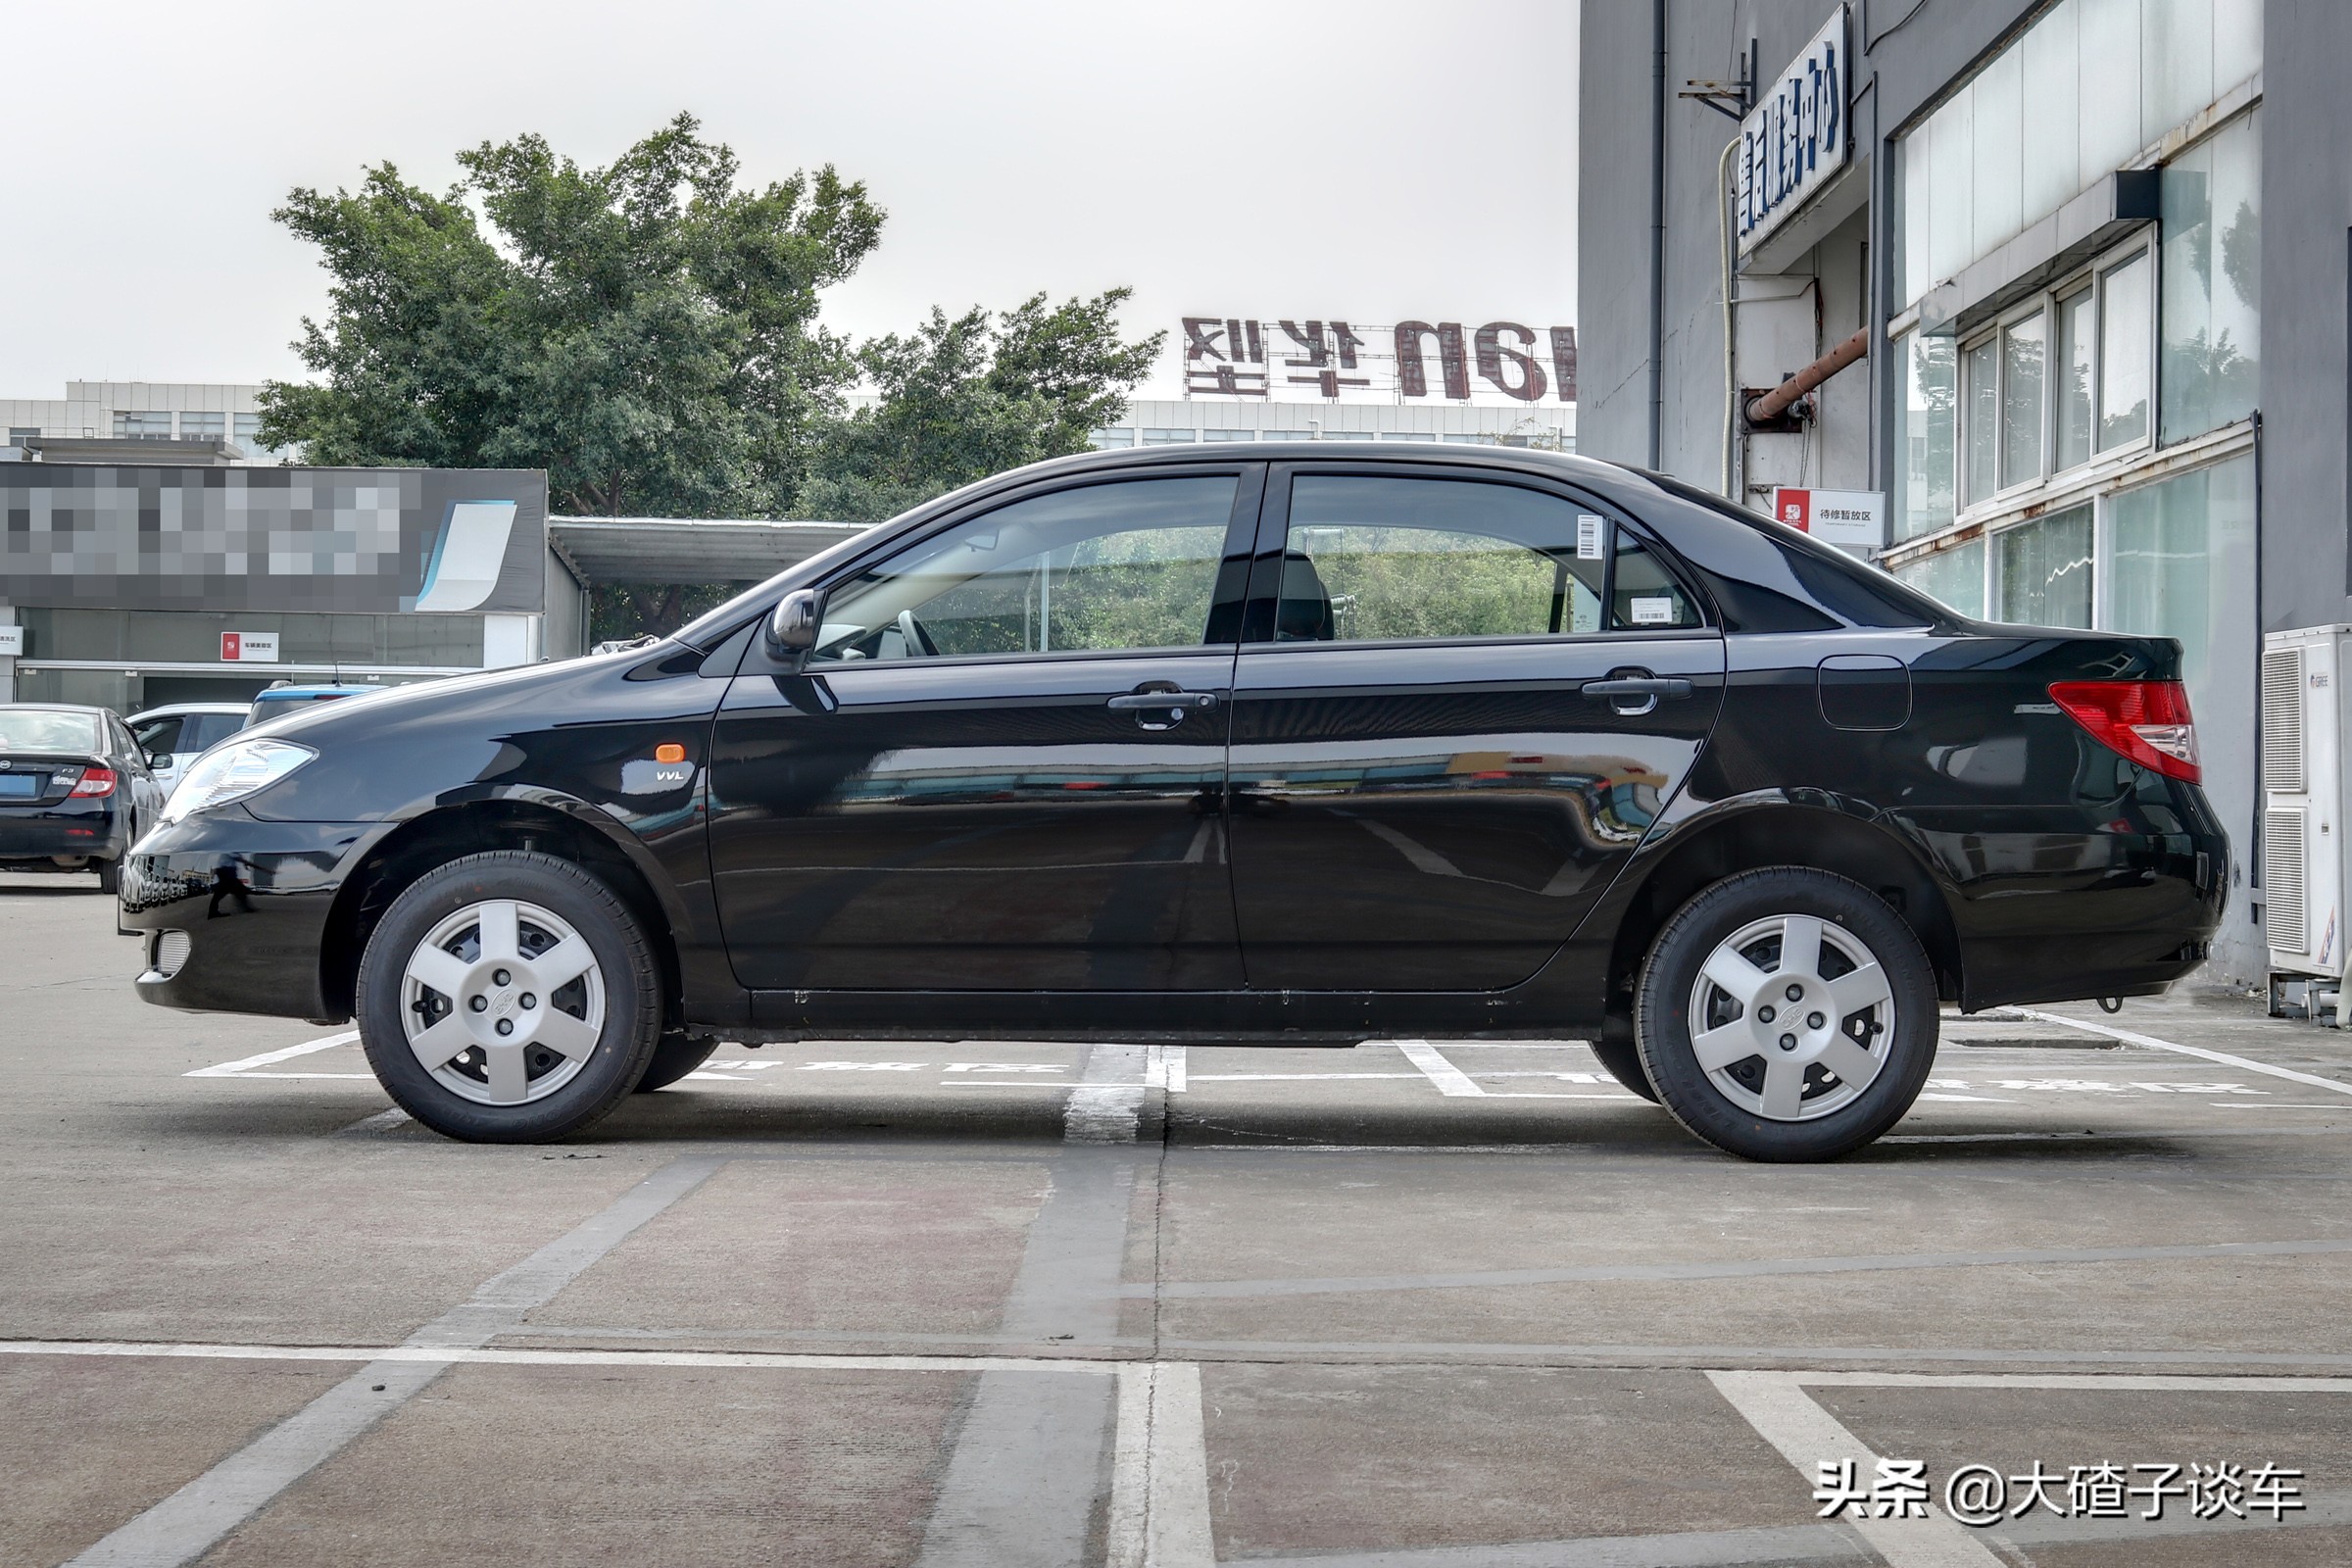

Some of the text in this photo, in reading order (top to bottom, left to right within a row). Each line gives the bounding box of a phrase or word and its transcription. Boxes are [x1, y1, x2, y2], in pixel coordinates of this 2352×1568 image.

[1820, 509, 1871, 521] 待修暂放区
[2315, 675, 2328, 688] GREE
[657, 771, 684, 781] VVL
